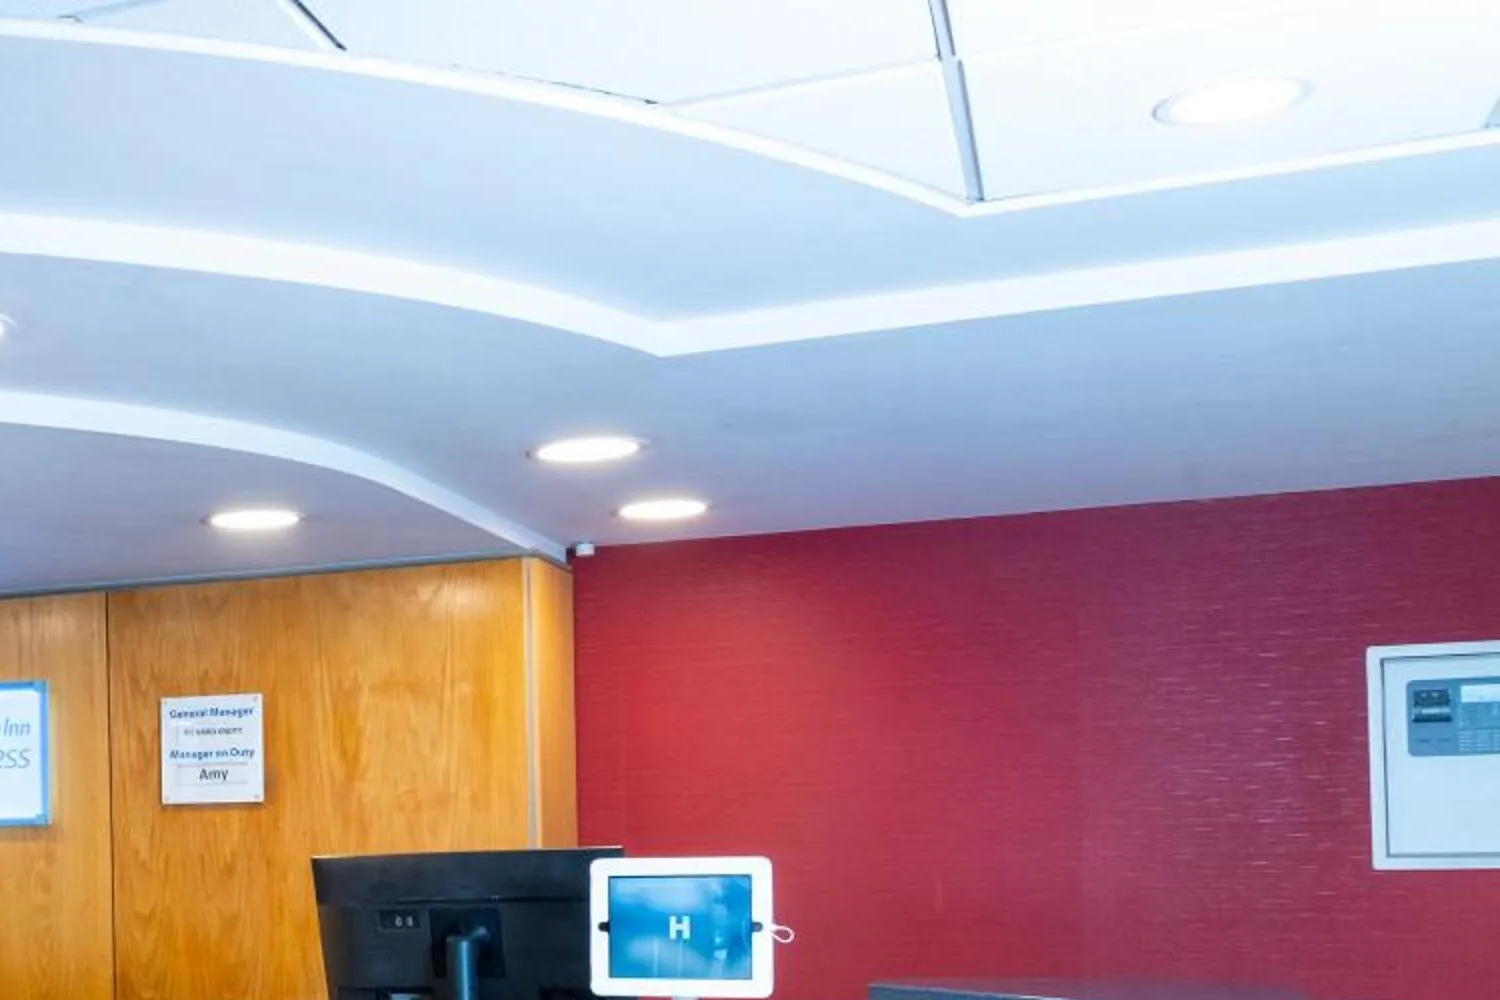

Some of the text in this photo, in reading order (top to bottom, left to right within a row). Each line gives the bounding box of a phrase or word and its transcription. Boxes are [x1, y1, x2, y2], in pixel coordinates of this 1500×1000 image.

[169, 706, 254, 719] General Manager
[3, 717, 31, 737] Inn
[169, 747, 255, 761] Manager on Duty
[199, 768, 229, 781] Amy
[669, 915, 691, 940] H
